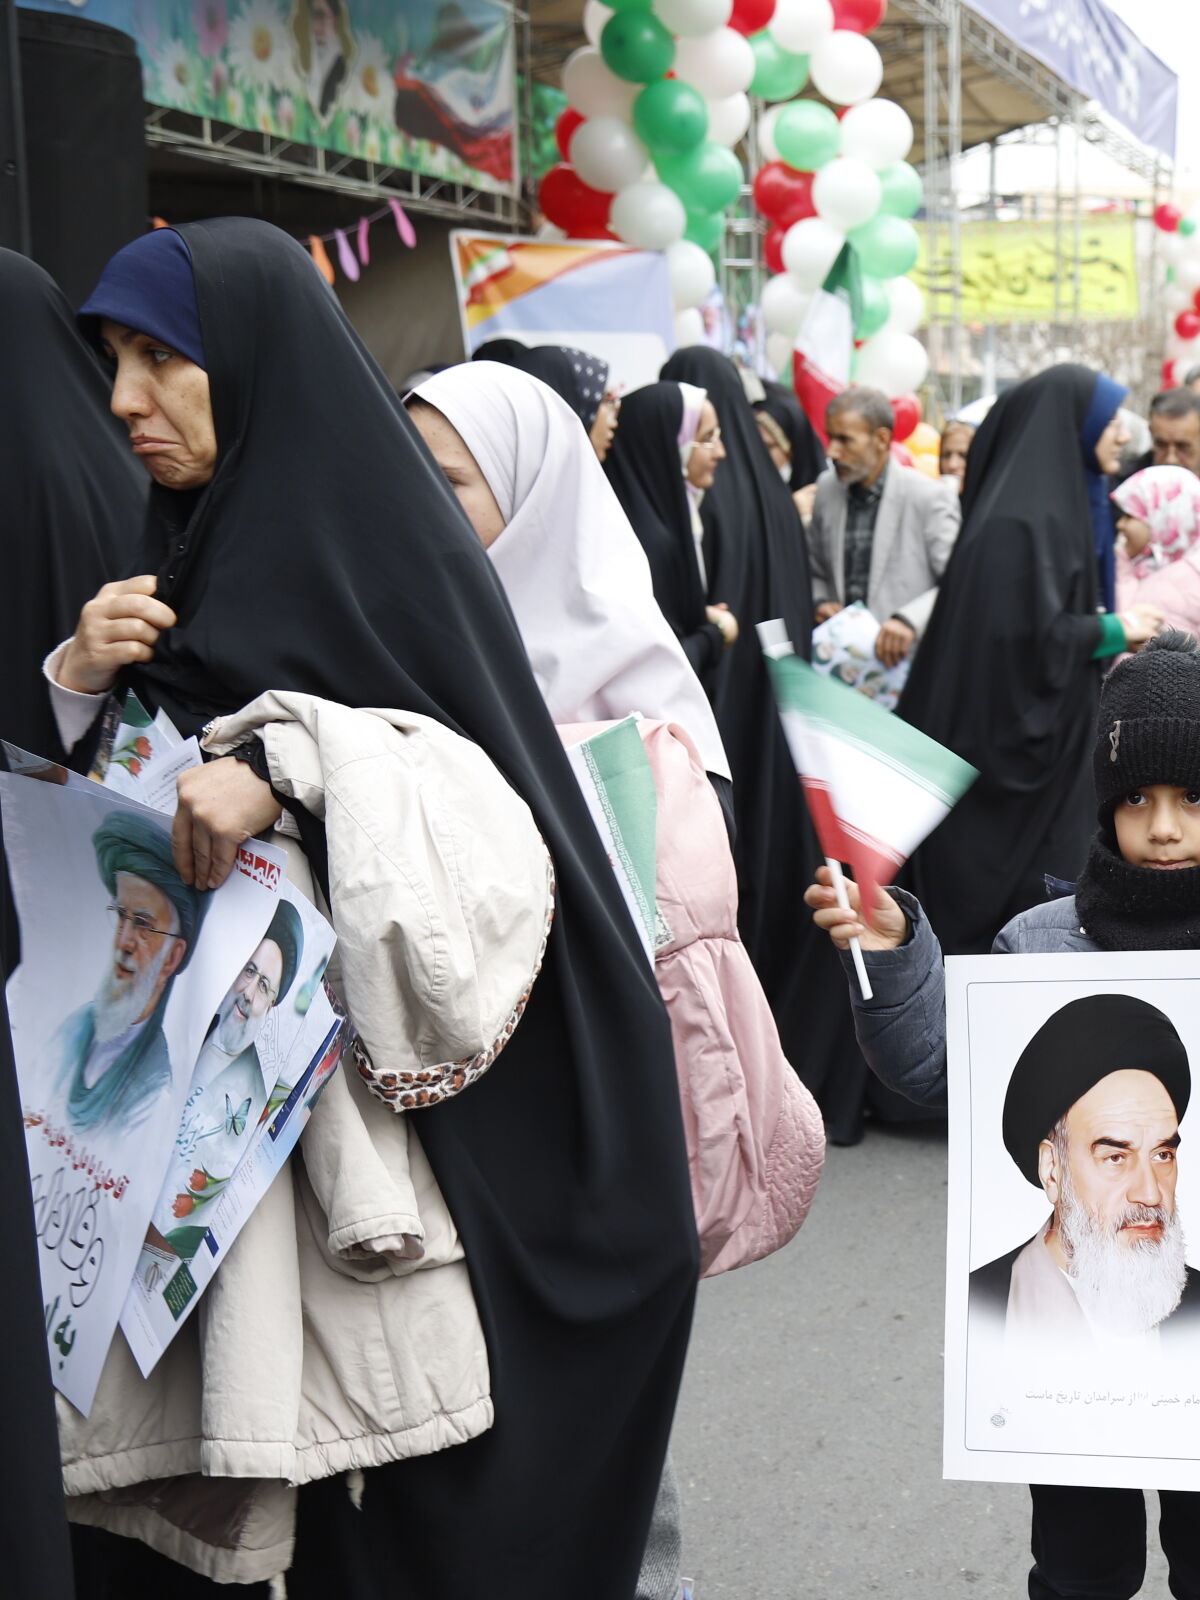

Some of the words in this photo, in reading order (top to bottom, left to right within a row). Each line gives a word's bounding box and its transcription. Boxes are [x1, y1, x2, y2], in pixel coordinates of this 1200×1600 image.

[1024, 1390, 1053, 1401] ماست
[1055, 1389, 1081, 1404] تاریخ
[1151, 1395, 1181, 1408] خمینی
